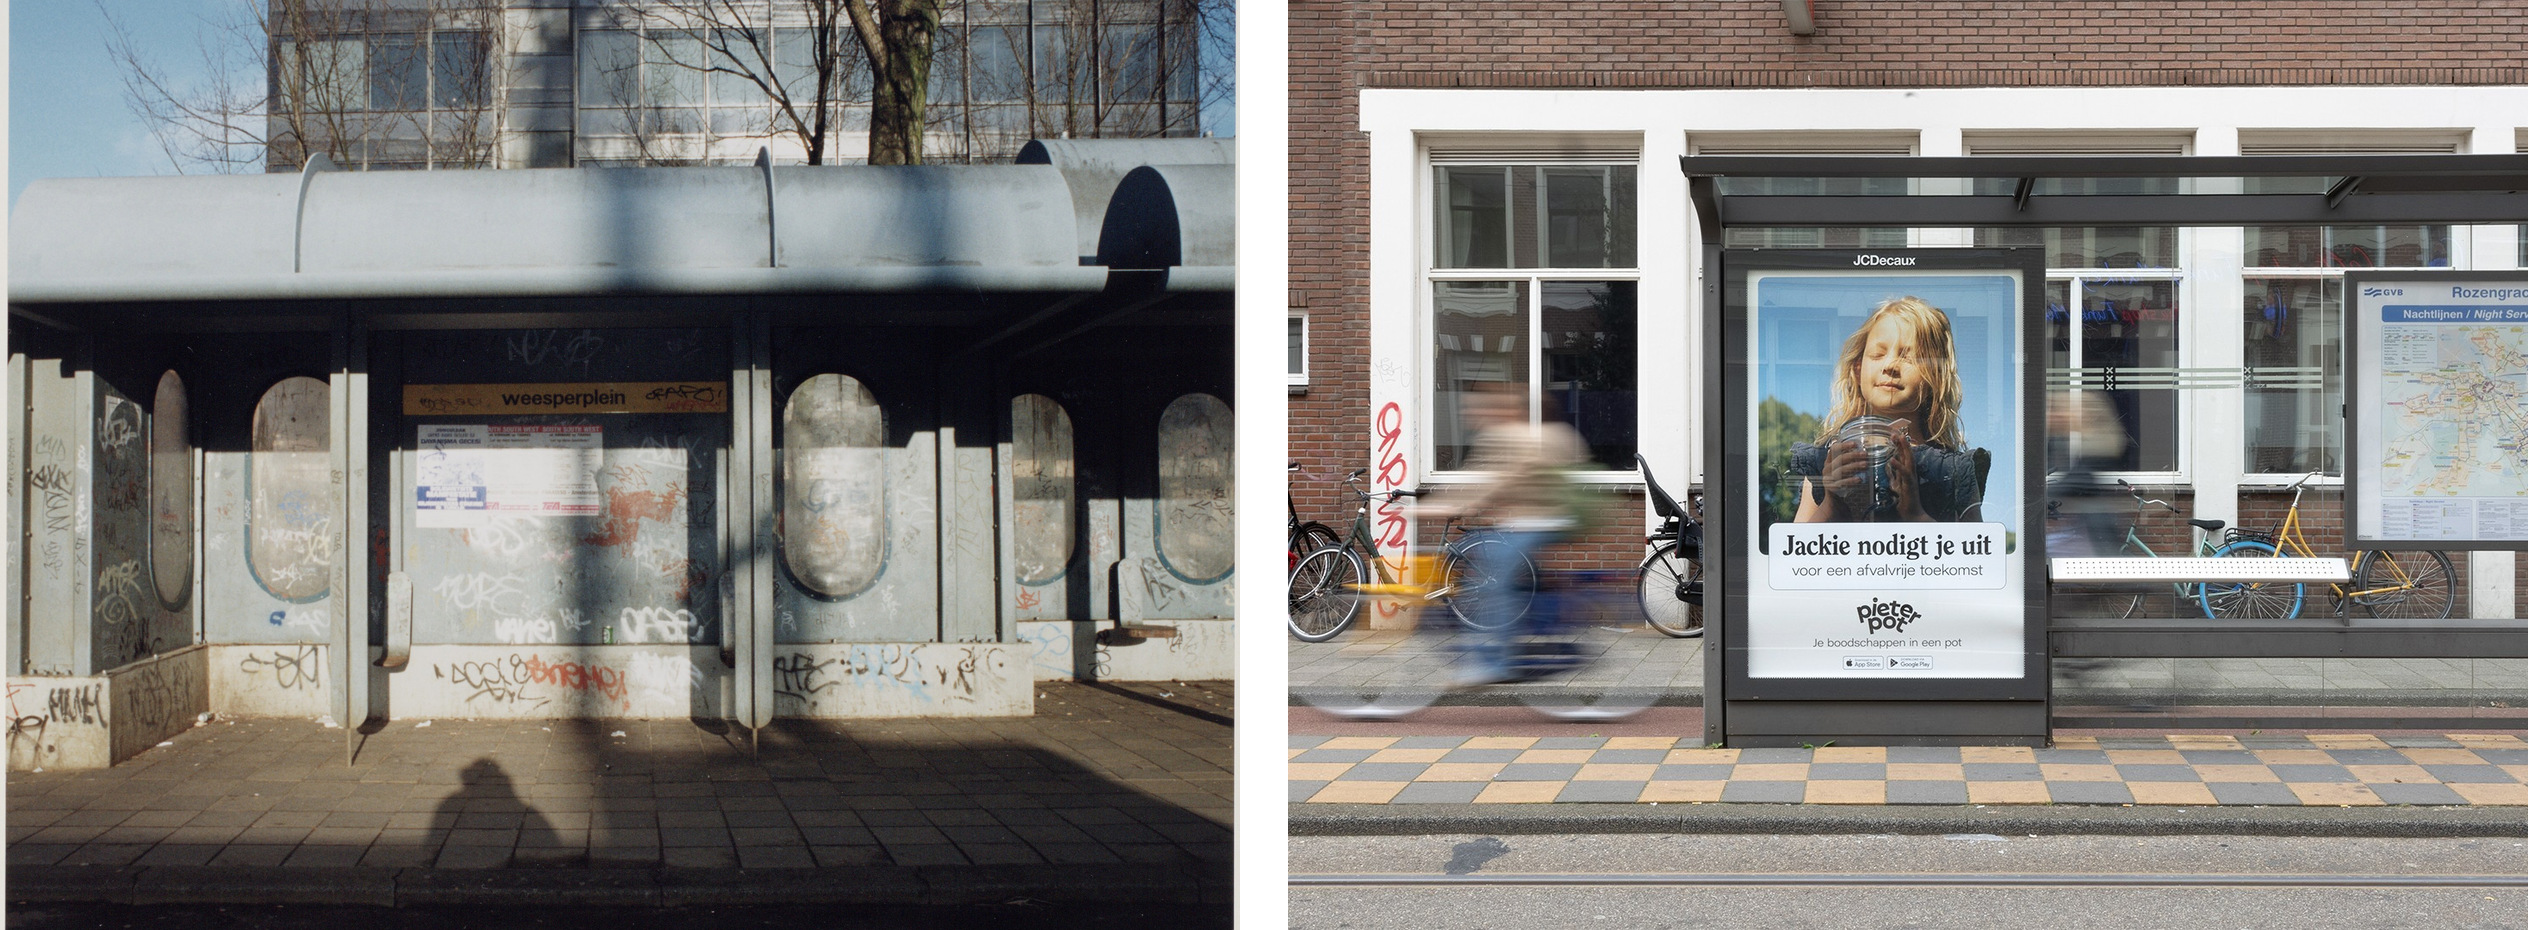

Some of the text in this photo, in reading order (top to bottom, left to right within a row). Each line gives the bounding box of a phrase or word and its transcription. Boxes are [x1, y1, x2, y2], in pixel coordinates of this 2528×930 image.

[1853, 254, 1916, 266] JCDecaux
[2403, 309, 2463, 321] Nachtlijnen
[2473, 309, 2503, 321] Night
[501, 389, 626, 408] weesperplein
[1782, 533, 1993, 561] Jackie nodigt je uit
[1792, 564, 1984, 579] voor een afvalvrije toekomst
[1856, 597, 1922, 624] pieter
[1867, 615, 1908, 635] pot
[1813, 638, 1962, 649] Je boodschappen in een pot
